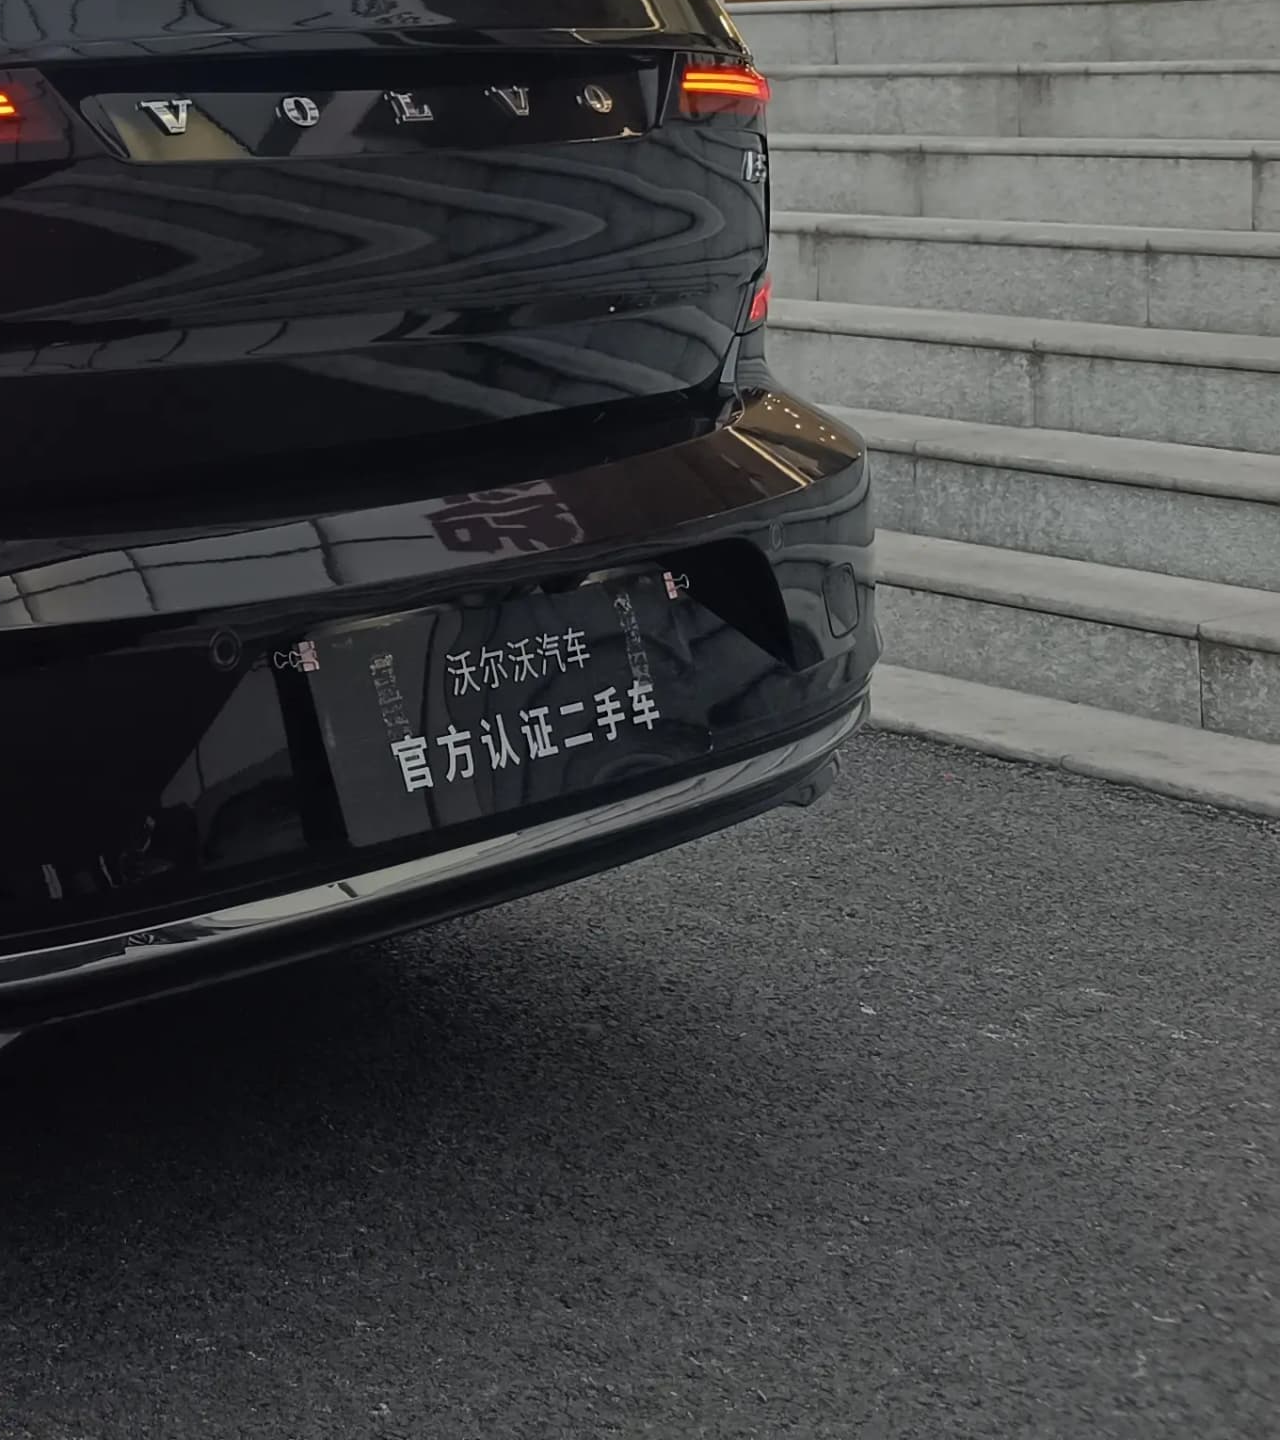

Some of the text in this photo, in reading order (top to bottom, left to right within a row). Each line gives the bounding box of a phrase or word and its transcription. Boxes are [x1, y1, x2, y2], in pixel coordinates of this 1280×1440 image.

[137, 83, 614, 135] VOLVO
[446, 627, 591, 696] 沃尔沃汽车
[391, 680, 661, 792] 官方认证二手车
